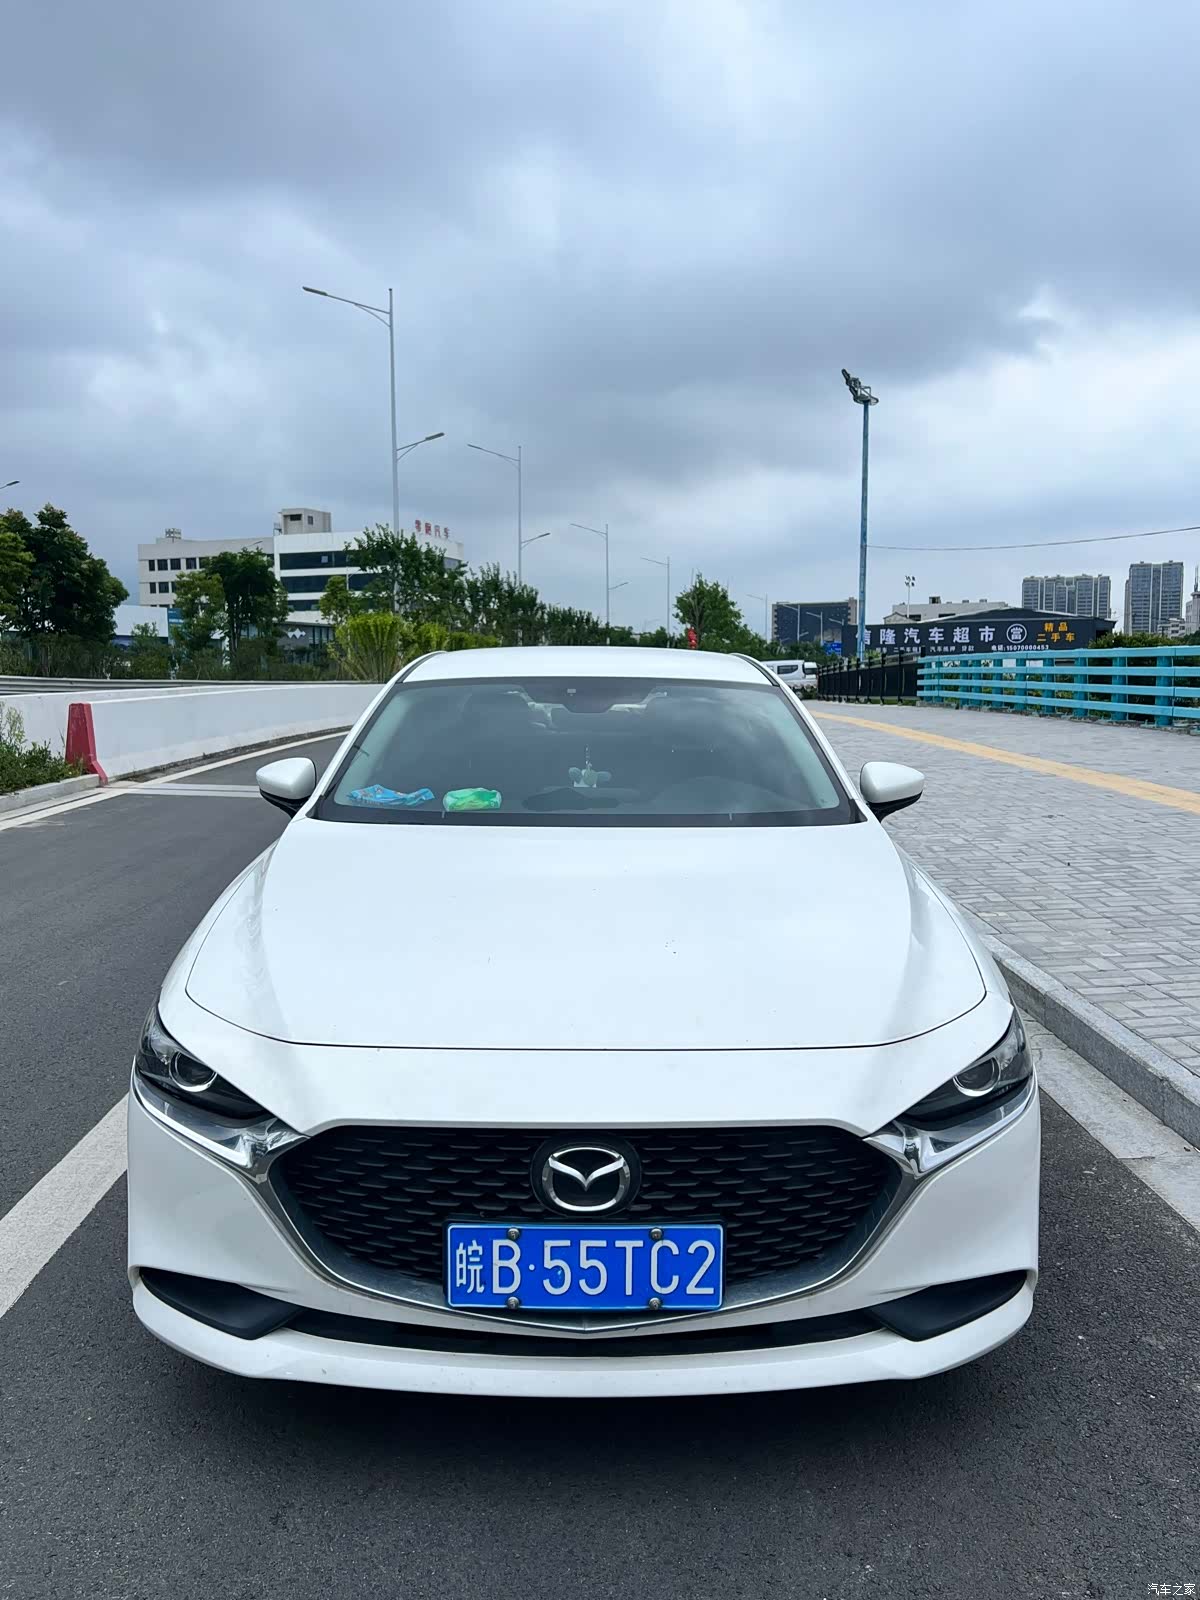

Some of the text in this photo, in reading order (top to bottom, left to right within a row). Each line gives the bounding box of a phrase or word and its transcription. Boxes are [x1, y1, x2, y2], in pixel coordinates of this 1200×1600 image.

[1044, 622, 1068, 632] 精品
[1037, 633, 1075, 643] 二手车
[455, 1239, 716, 1296] 皖B·55TC2
